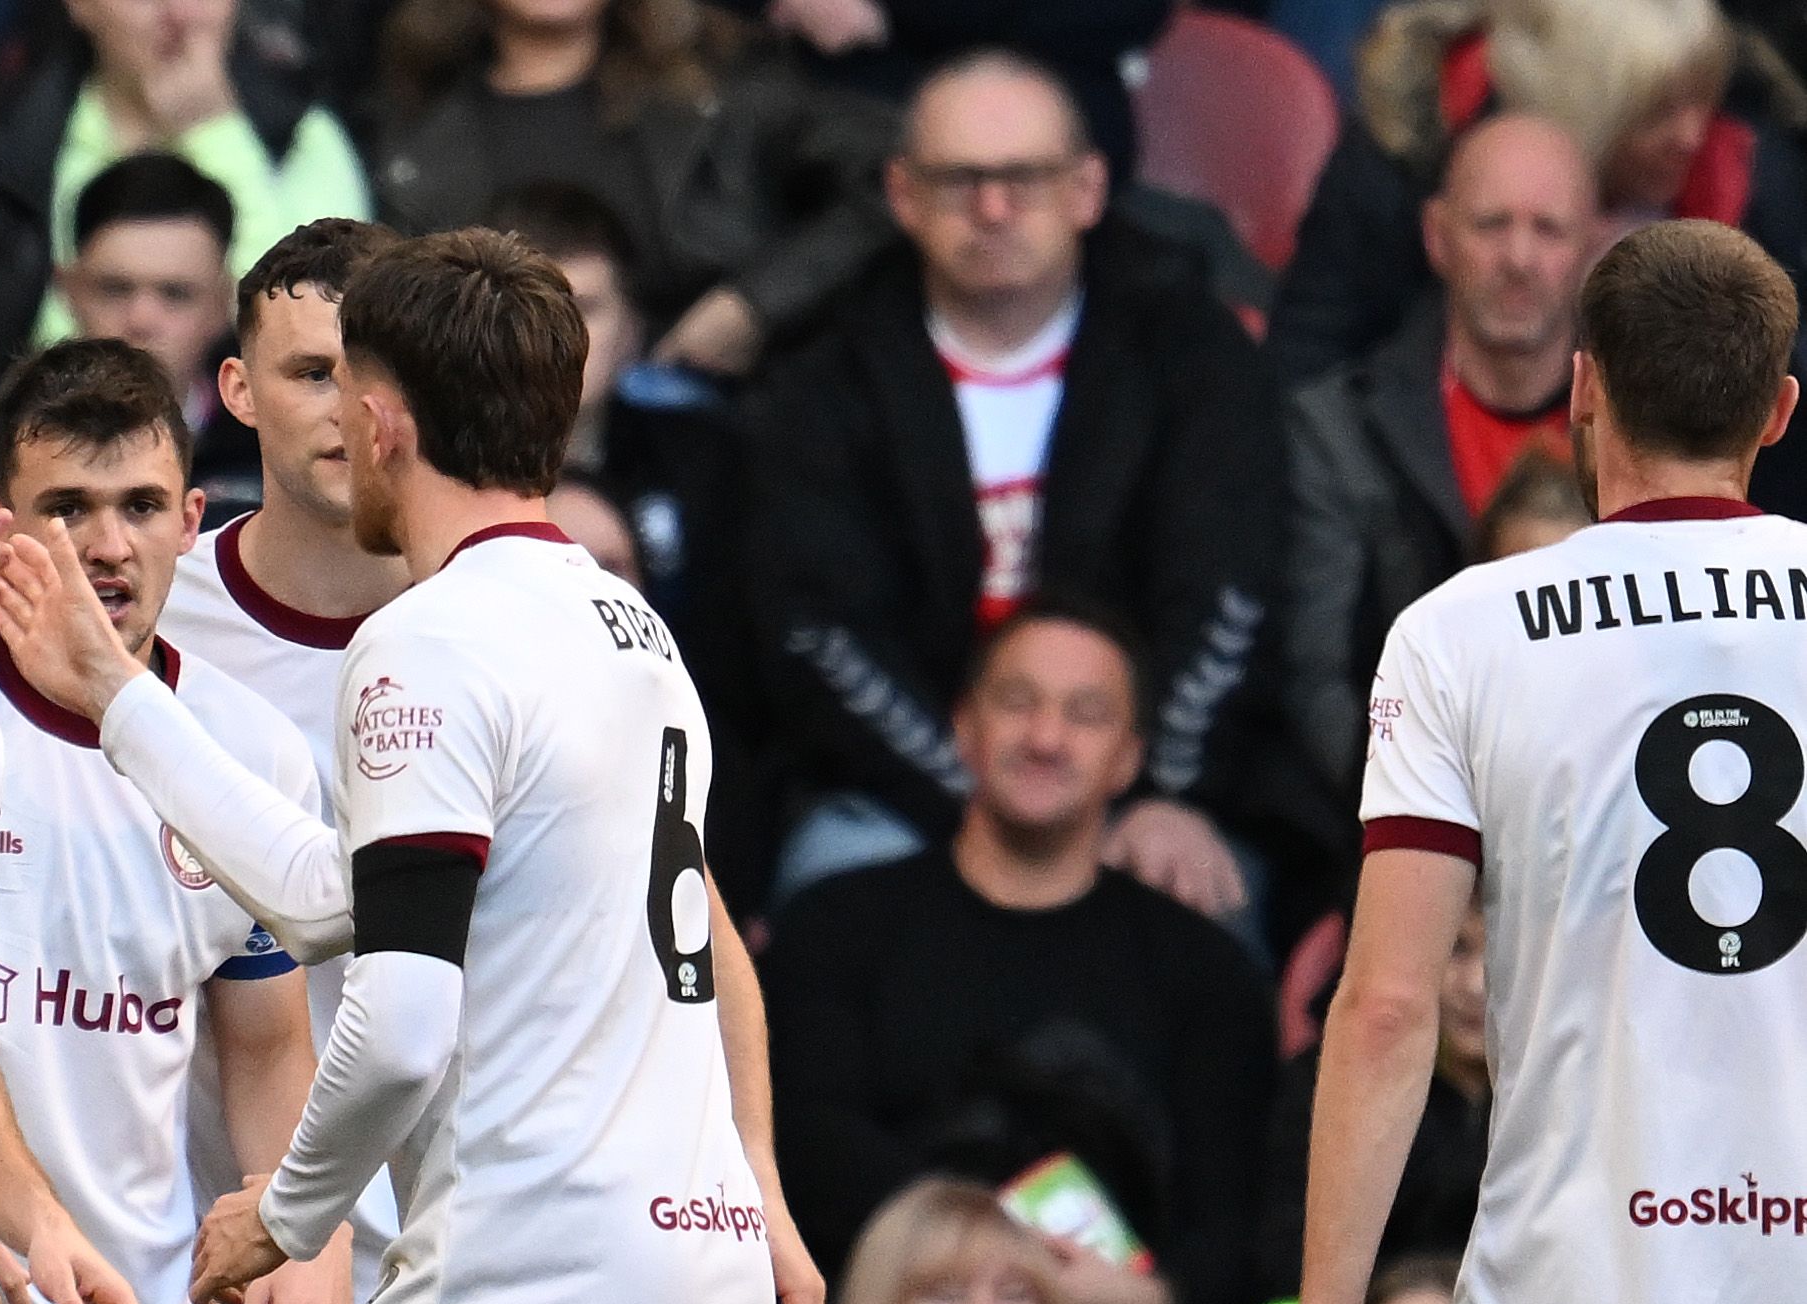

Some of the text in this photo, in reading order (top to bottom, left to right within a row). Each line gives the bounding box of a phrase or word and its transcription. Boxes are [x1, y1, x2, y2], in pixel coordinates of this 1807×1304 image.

[590, 598, 672, 662] BIRD
[376, 730, 434, 753] BATH
[647, 726, 714, 1004] 6
[1634, 694, 1807, 974] 8
